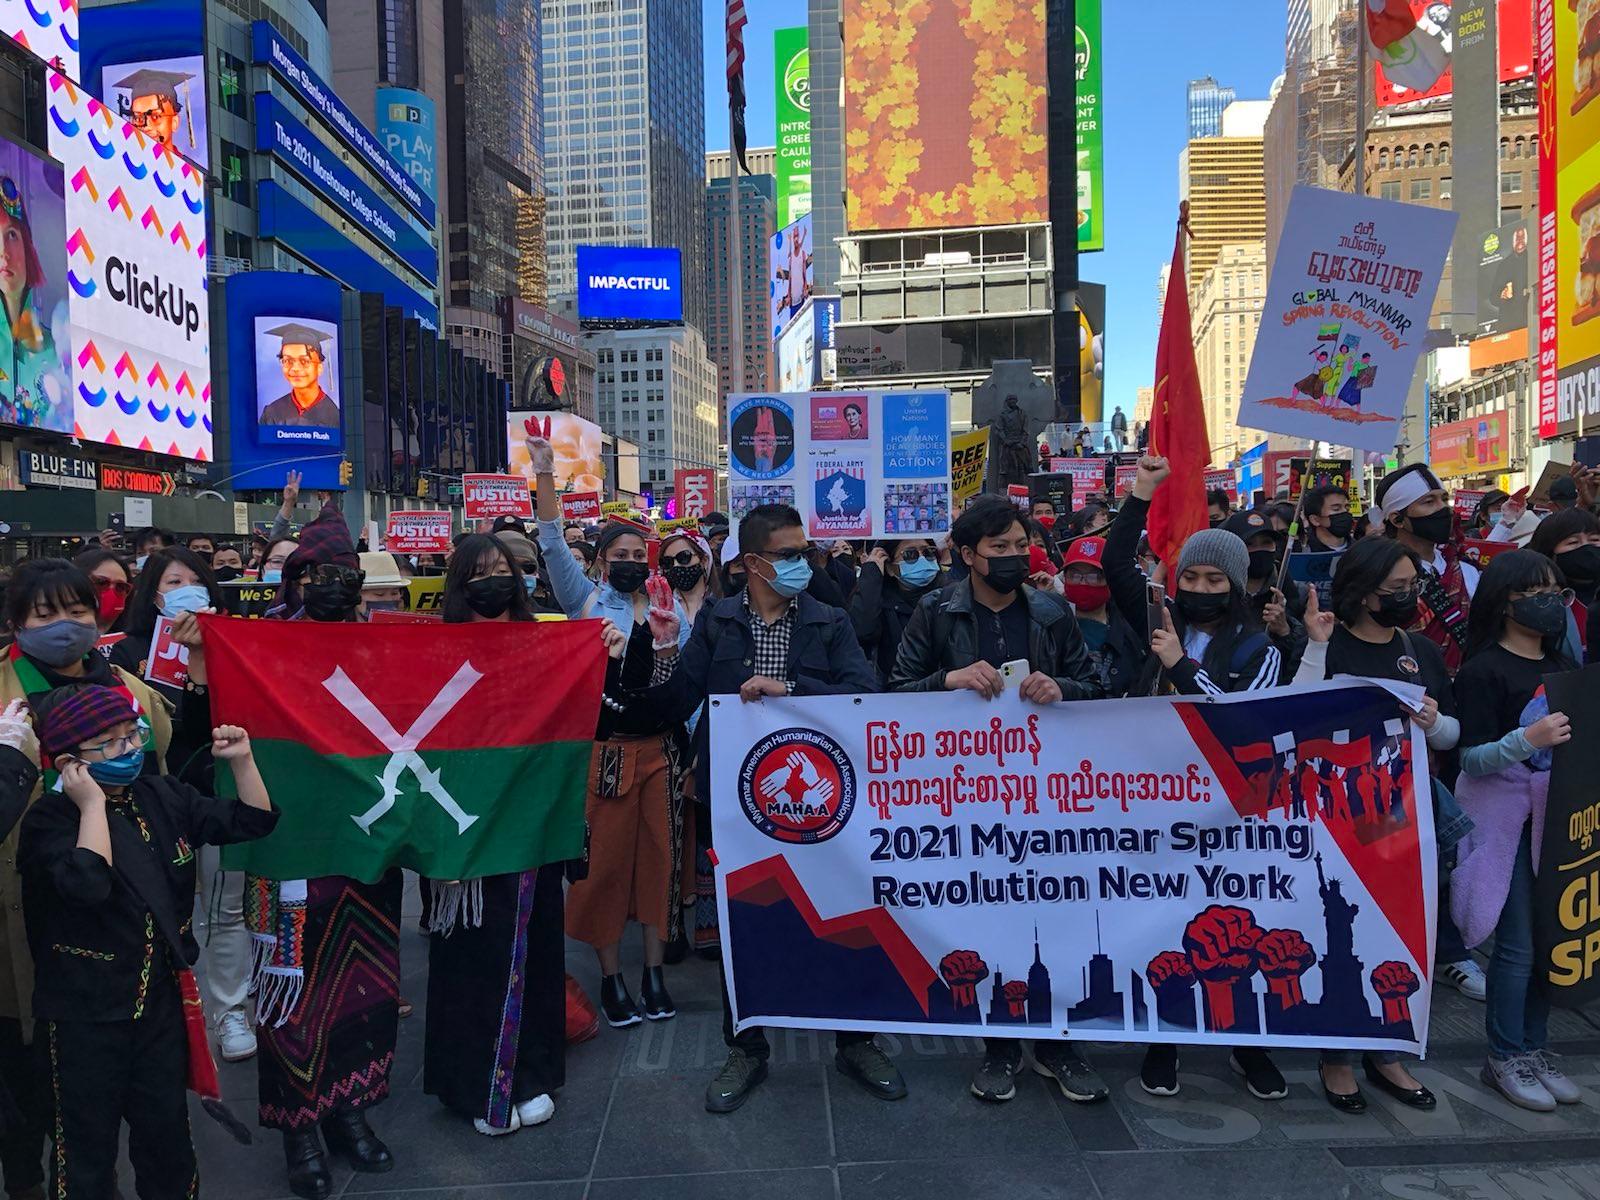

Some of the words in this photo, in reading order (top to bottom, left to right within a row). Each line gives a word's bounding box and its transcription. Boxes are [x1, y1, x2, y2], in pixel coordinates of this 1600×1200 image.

[1459, 7, 1485, 23] NEW
[1458, 19, 1486, 37] BOOK
[1460, 33, 1484, 48] FROM
[272, 39, 300, 82] Morgan
[301, 70, 331, 113] Stanley's
[783, 135, 811, 145] GREE
[275, 121, 292, 151] The
[293, 138, 311, 168] 2021
[313, 155, 350, 201] Morehouse
[351, 190, 373, 223] College
[372, 211, 396, 242] Scholars
[589, 276, 670, 291] IMPACTFUL
[1541, 211, 1556, 343] HERSHEY'S
[105, 256, 200, 341] ClickUp
[1292, 288, 1340, 305] GLOBAL
[1347, 291, 1412, 336] MYANMAR
[1282, 303, 1325, 327] SPRING
[1329, 302, 1409, 351] REVOLUTION
[1541, 348, 1556, 426] STORE
[1558, 370, 1586, 423] HEY'S
[277, 430, 311, 439] Damonte
[312, 431, 330, 440] Rush
[913, 434, 940, 442] MANY
[31, 453, 67, 474] BLUE
[74, 459, 96, 478] FIN
[889, 457, 943, 468] ACTION?
[951, 441, 986, 468] REE
[1316, 461, 1342, 469] Support
[104, 468, 123, 489] DOS
[124, 471, 162, 494] CAMINOS
[1205, 480, 1236, 491] STICE
[467, 489, 528, 502] JUSTICE
[564, 499, 598, 511] BURMA
[684, 474, 708, 518] tkts
[816, 521, 867, 530] MYANMAR
[849, 514, 859, 522] for
[387, 525, 449, 537] JUSTICE
[239, 589, 261, 600] We
[771, 732, 834, 752] Humanitarian
[866, 721, 925, 774] မြန်မာ
[935, 714, 1042, 767] အမေရိကန်
[743, 740, 774, 780] American
[831, 749, 847, 766] Aid
[836, 764, 853, 821] Association
[867, 764, 1039, 820] လူသားချင်းစာနာမှု
[1047, 759, 1212, 813] ကူညီရေးအသင်း
[743, 781, 764, 825] Myanmar
[869, 824, 960, 862] 2021
[971, 822, 1163, 865] Myanmar
[1170, 820, 1313, 861] Spring
[872, 868, 1089, 908] Revolution
[1099, 865, 1189, 901] New
[1194, 863, 1297, 902] York
